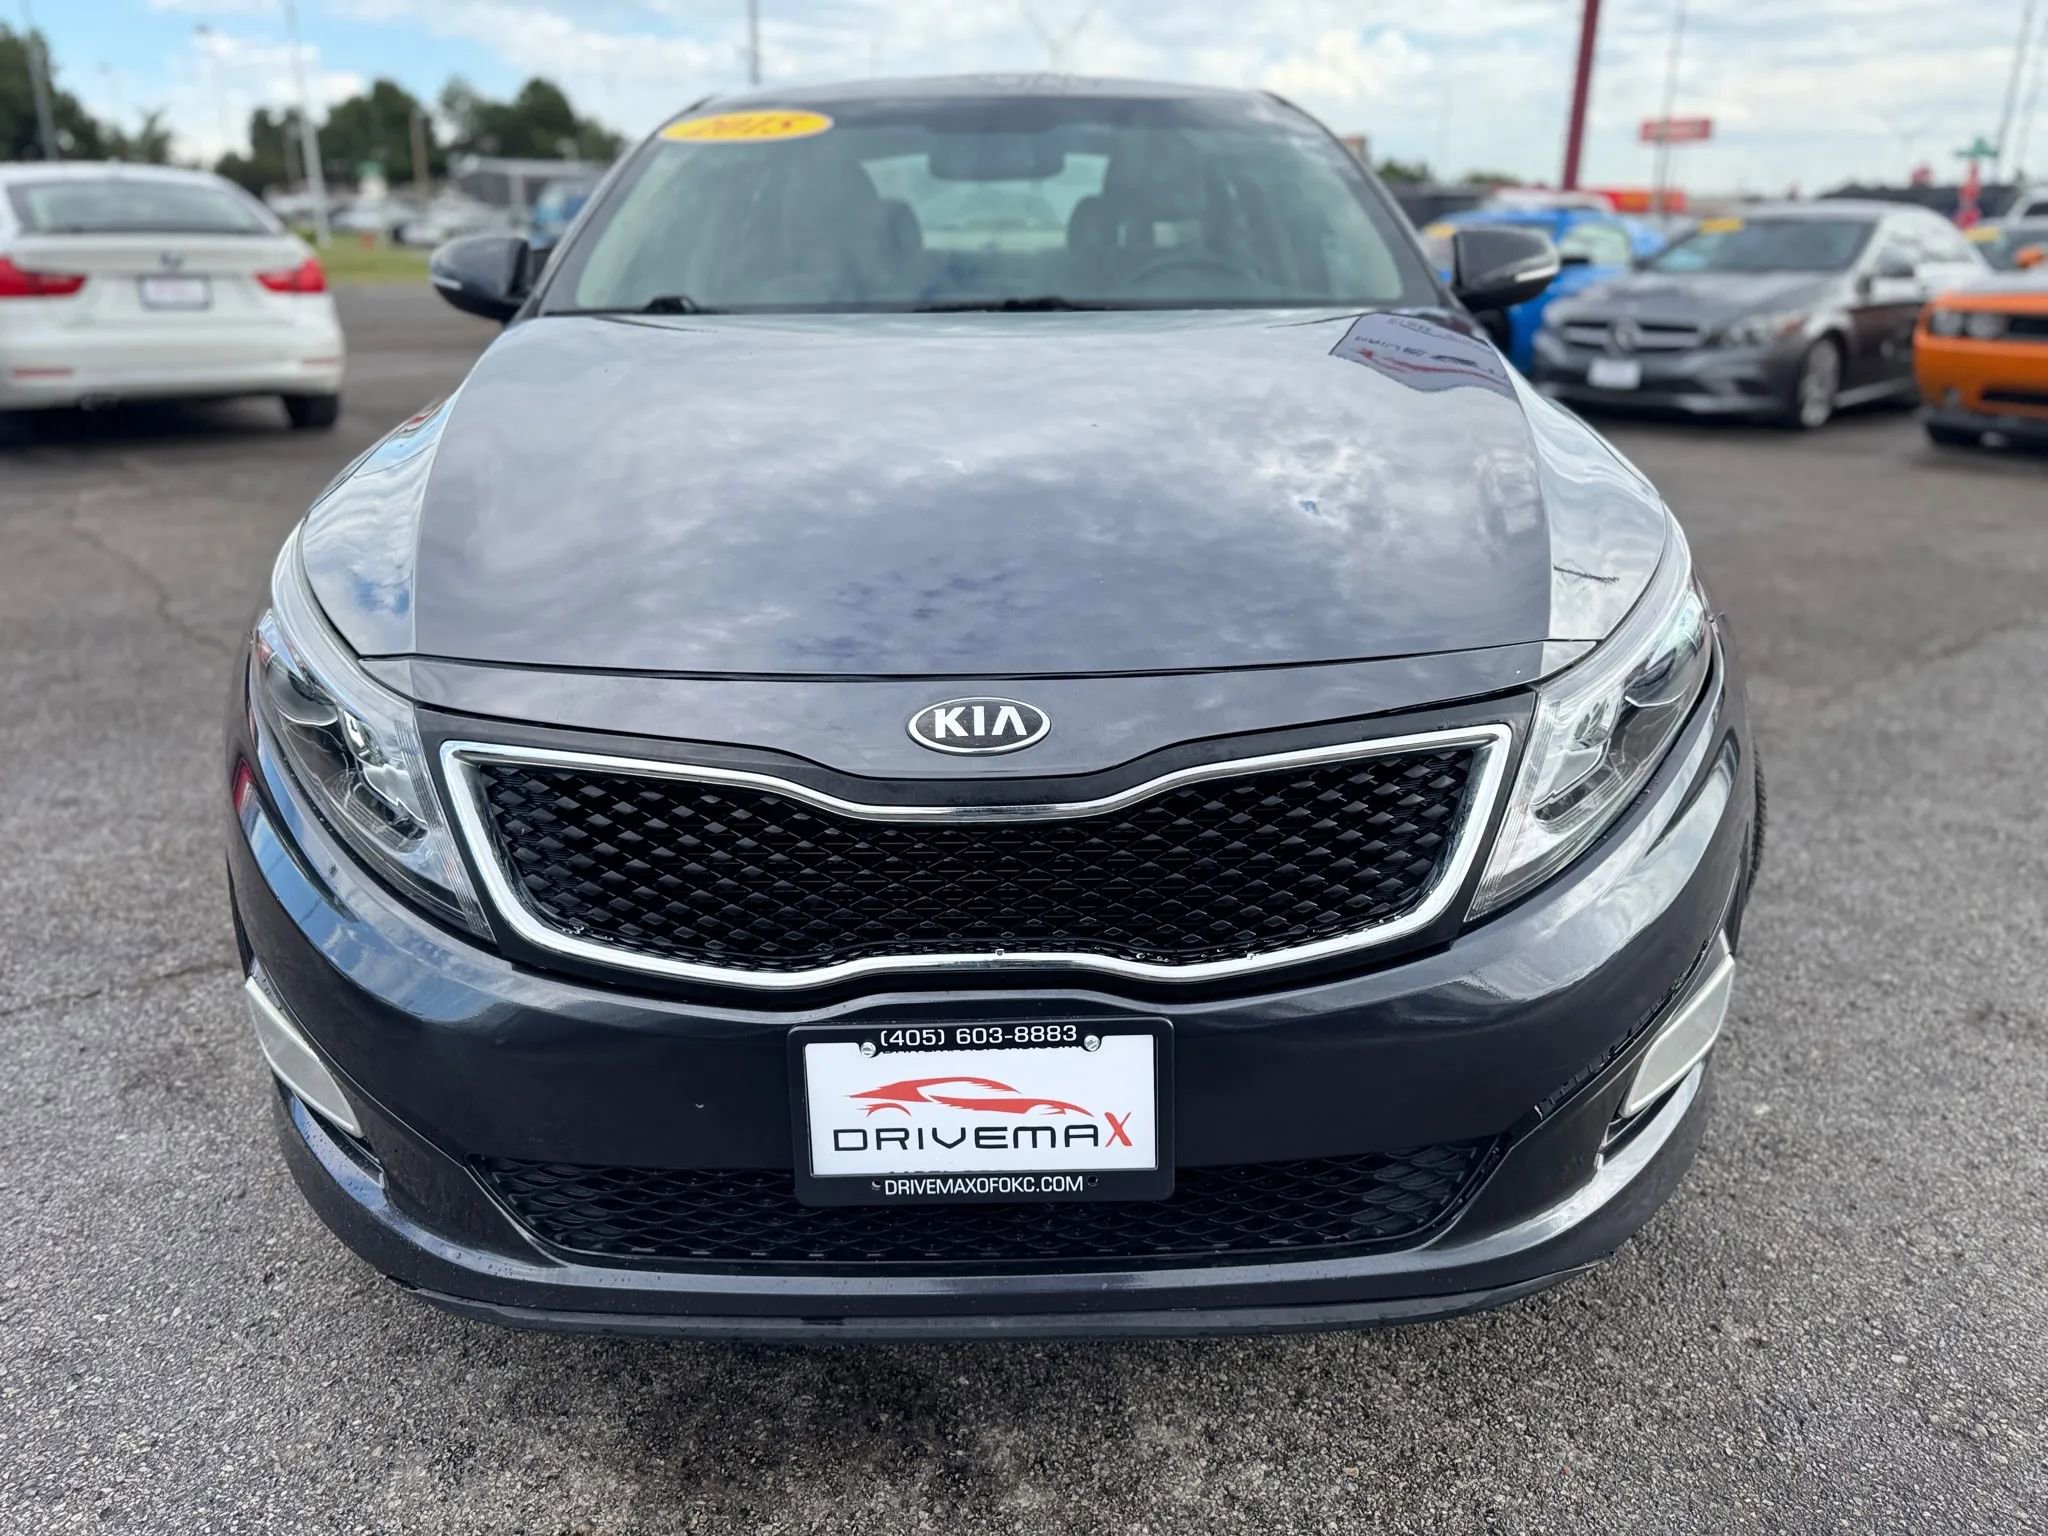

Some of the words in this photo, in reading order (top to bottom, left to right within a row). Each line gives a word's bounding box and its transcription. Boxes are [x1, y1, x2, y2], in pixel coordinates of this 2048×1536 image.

[933, 705, 1028, 739] KIA
[880, 1029, 945, 1047] (405)
[956, 1025, 1077, 1045] 603-8883
[833, 1111, 1133, 1151] DRIVEMAX
[885, 1175, 1084, 1195] DRIVEMAXOFOKC.COM
